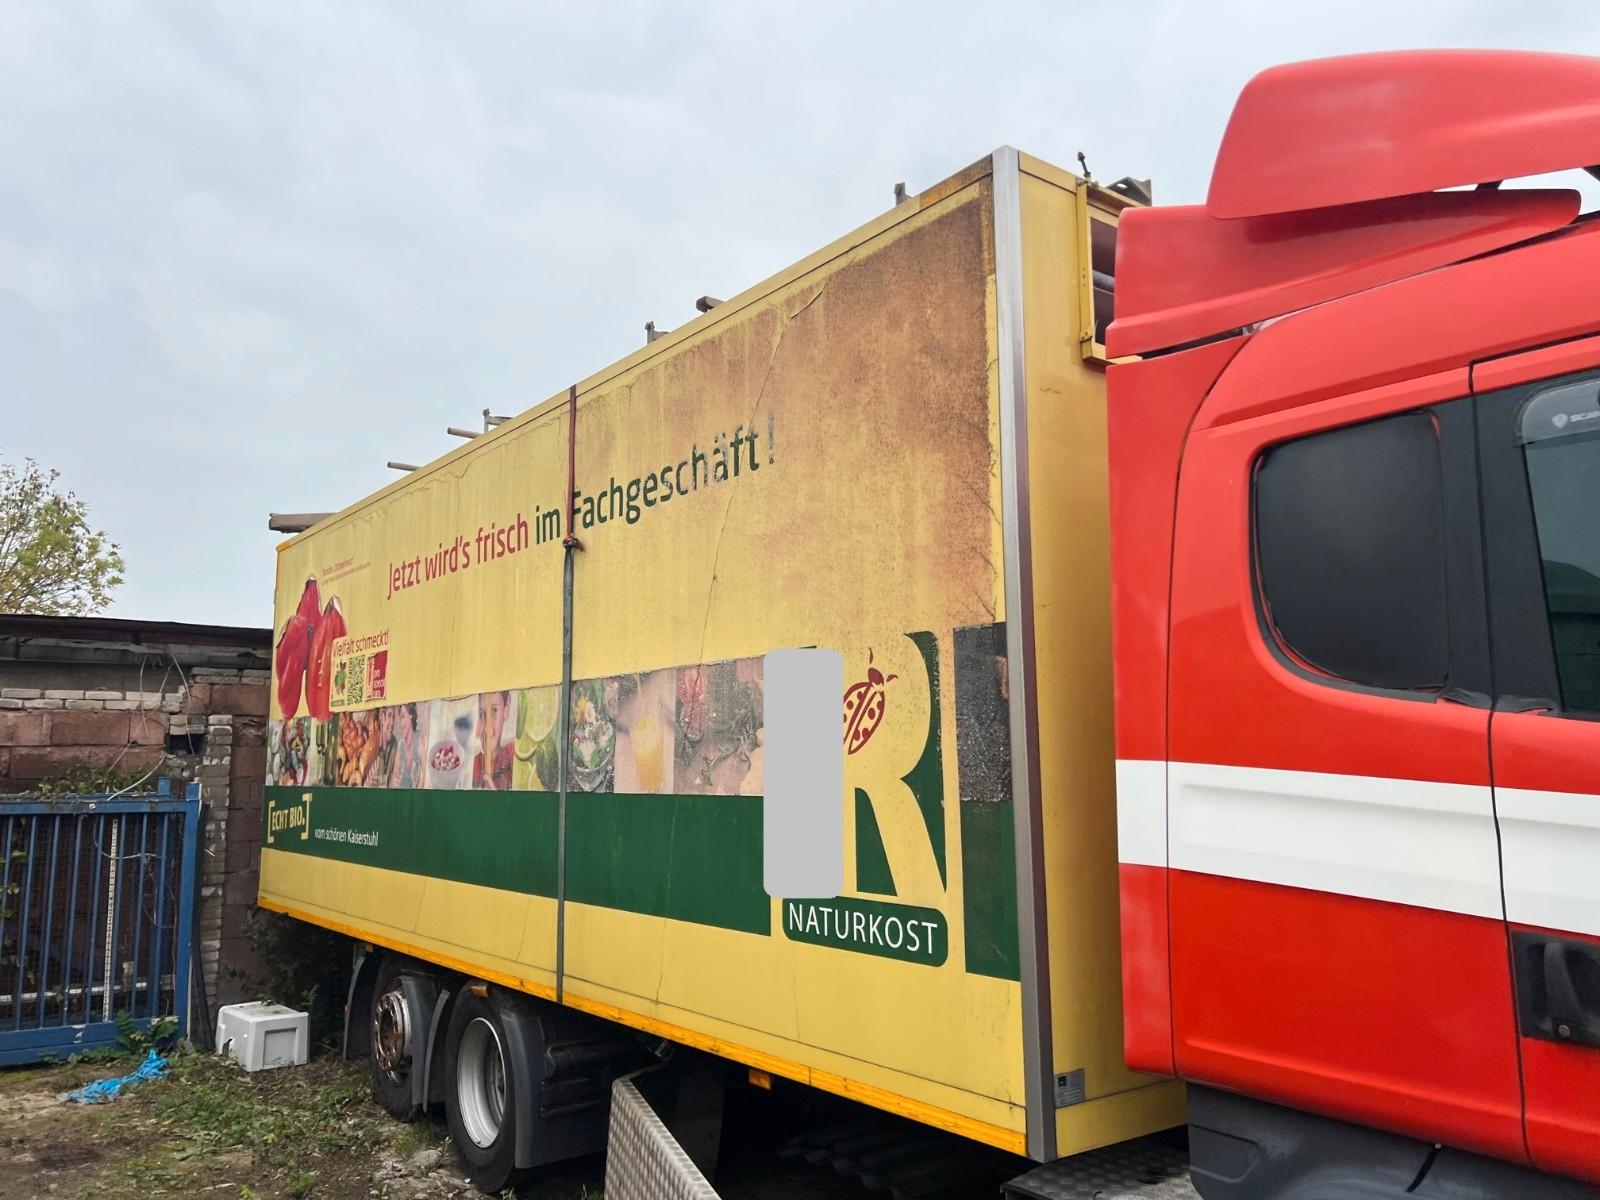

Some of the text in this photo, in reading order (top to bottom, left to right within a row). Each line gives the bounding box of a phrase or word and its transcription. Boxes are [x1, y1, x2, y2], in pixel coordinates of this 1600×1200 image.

[387, 555, 421, 600] Jetzt
[425, 535, 470, 581] wird's
[475, 512, 529, 564] frisch
[536, 505, 560, 544] im
[315, 826, 379, 846] vom schönen Kaiserstuhl
[788, 901, 939, 955] NATURKOST
